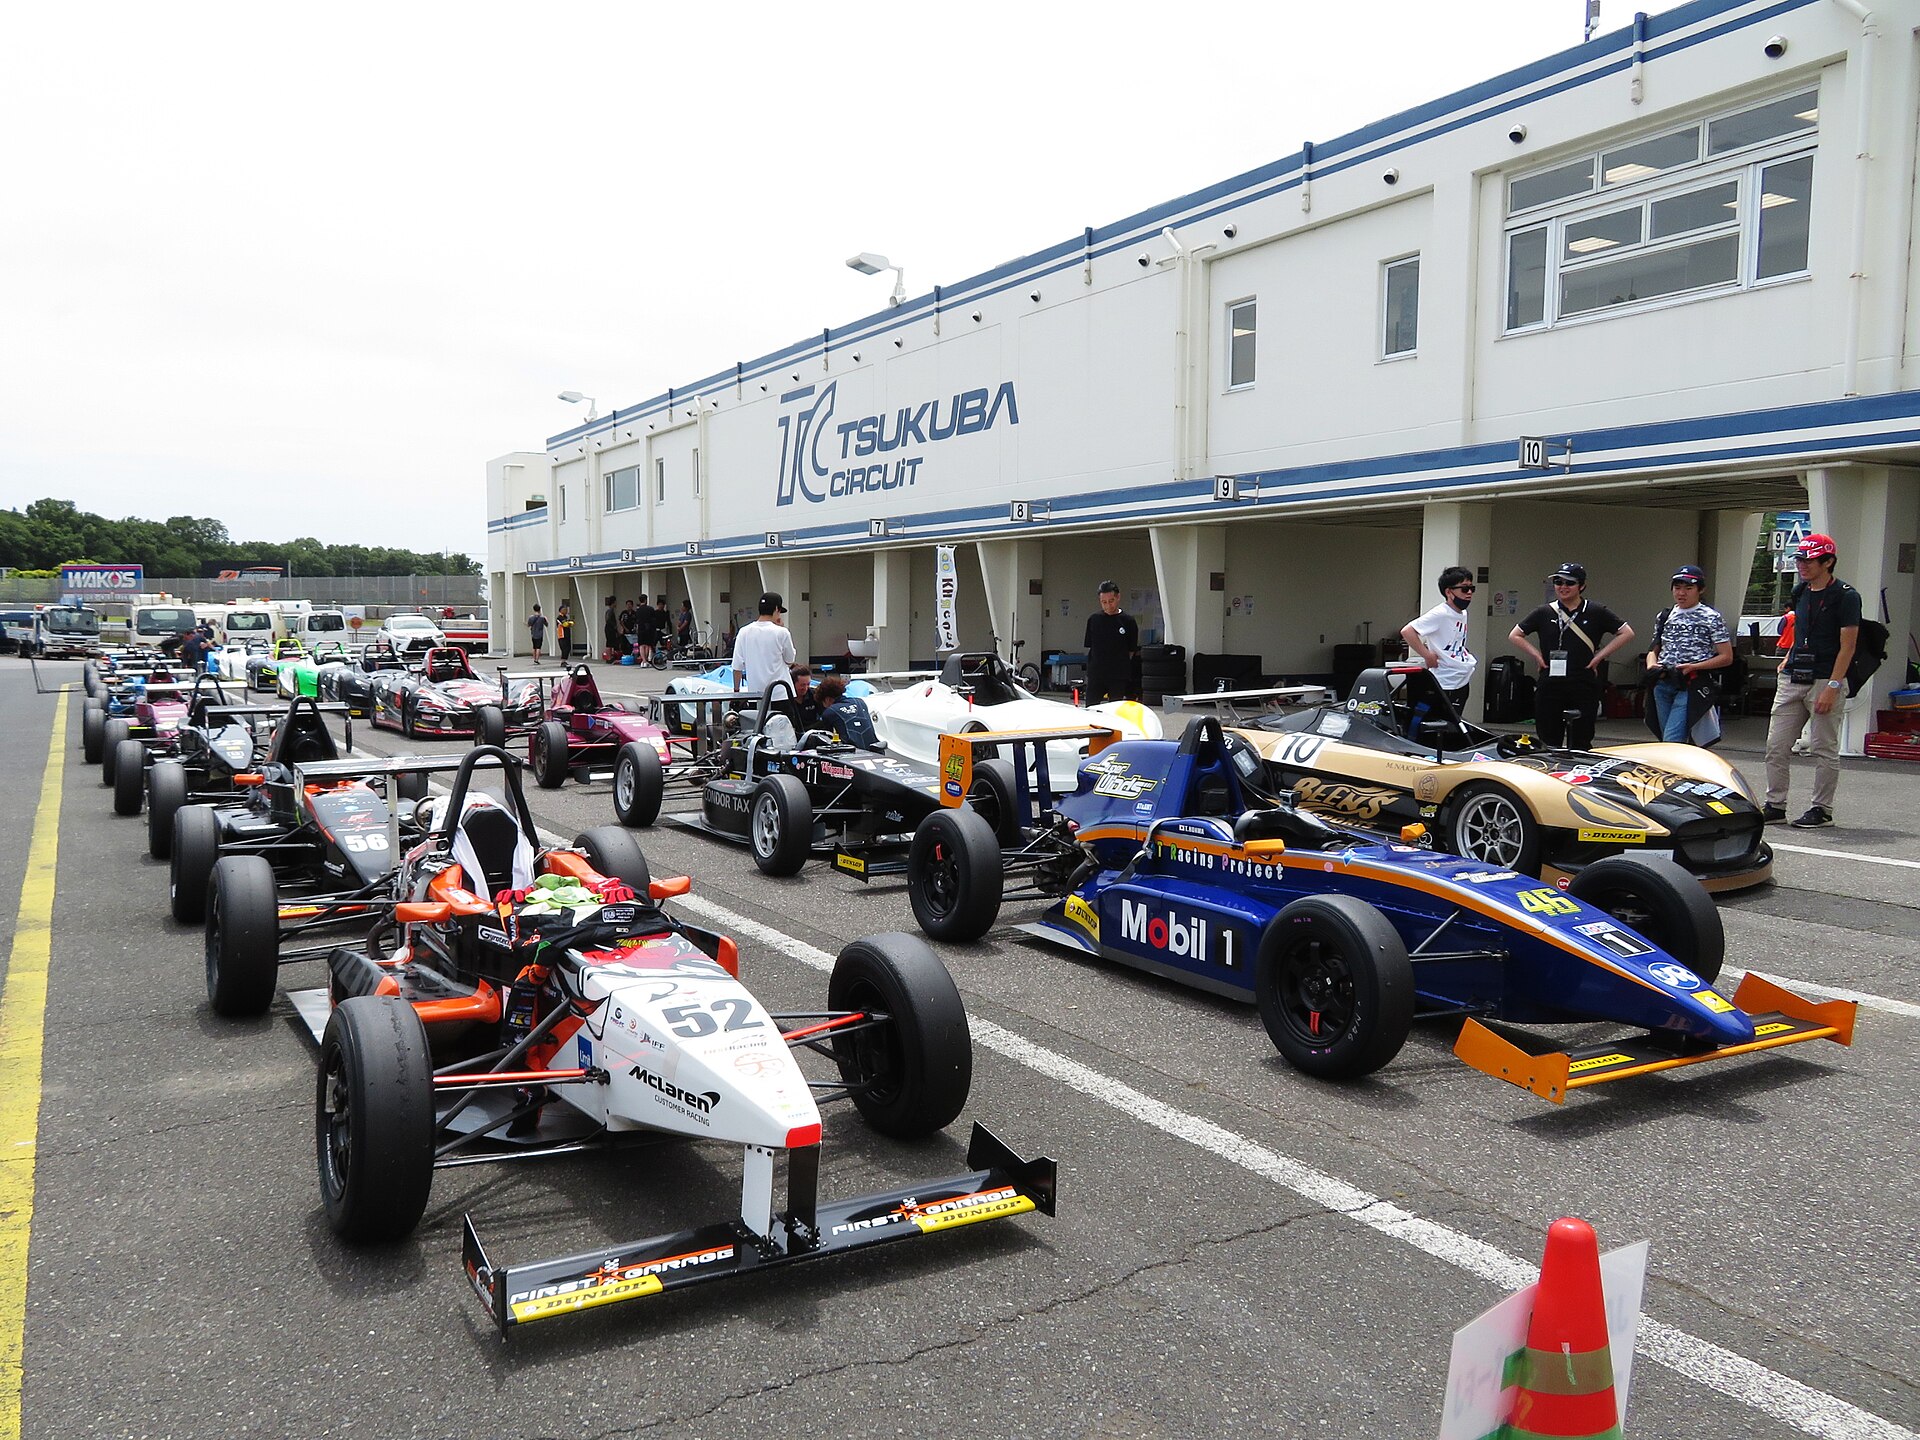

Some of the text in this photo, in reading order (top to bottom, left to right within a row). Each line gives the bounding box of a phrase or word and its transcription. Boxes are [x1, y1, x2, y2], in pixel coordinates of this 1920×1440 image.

[837, 381, 1019, 459] TSUKUBA
[1526, 442, 1540, 464] 10
[1221, 479, 1230, 497] 9
[1017, 503, 1024, 518] 8
[875, 522, 882, 534] 7
[690, 544, 696, 554] 5
[769, 535, 776, 545] 6
[1775, 532, 1782, 549] 9
[1281, 734, 1325, 763] 10
[806, 765, 818, 784] 11
[704, 788, 731, 809] CONDOR
[344, 833, 389, 852] 56
[1591, 831, 1641, 840] DUNLOP
[843, 858, 862, 868] DUNLOP
[1170, 843, 1214, 869] Racing
[1221, 853, 1284, 881] Project
[1516, 888, 1582, 917] 46
[1075, 906, 1097, 930] DUNLOP
[1121, 898, 1233, 966] Mobil 1
[1602, 933, 1643, 953] 1
[662, 999, 764, 1038] 52
[1570, 1056, 1619, 1069] DUNLOP
[629, 1065, 711, 1113] McLaren
[654, 1094, 710, 1127] CUSTOMER RACING
[832, 1188, 1017, 1236] FIRST GARAGE
[942, 1200, 1021, 1223] DUNLOP
[510, 1248, 735, 1305] FIRST GARAGE
[545, 1281, 647, 1310] DUNLOP
